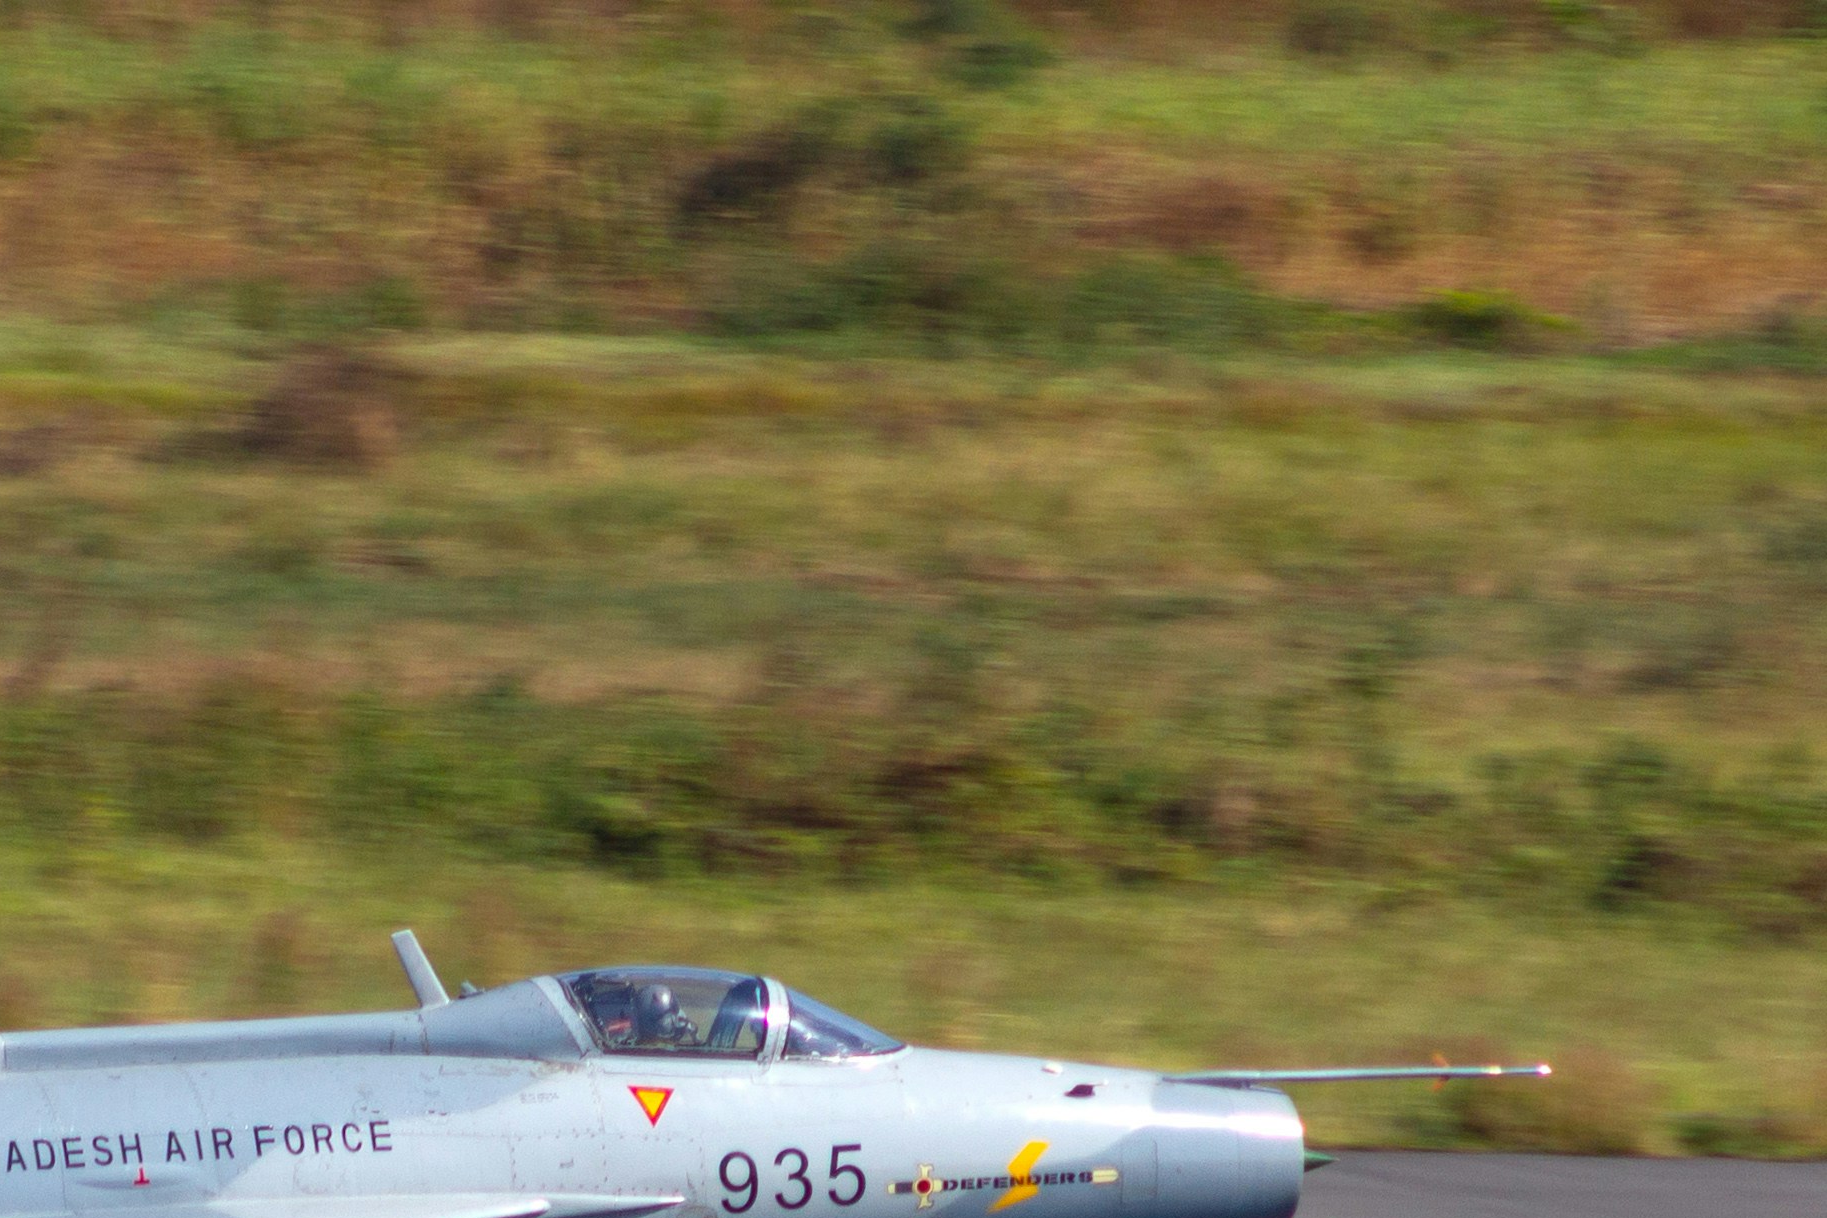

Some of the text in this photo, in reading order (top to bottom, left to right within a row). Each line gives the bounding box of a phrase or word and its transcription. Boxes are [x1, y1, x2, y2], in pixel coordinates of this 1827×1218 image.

[165, 1127, 236, 1163] AIR
[253, 1120, 394, 1158] FORCE
[718, 1143, 867, 1214] 935
[942, 1171, 1093, 1191] DEFENDERS
